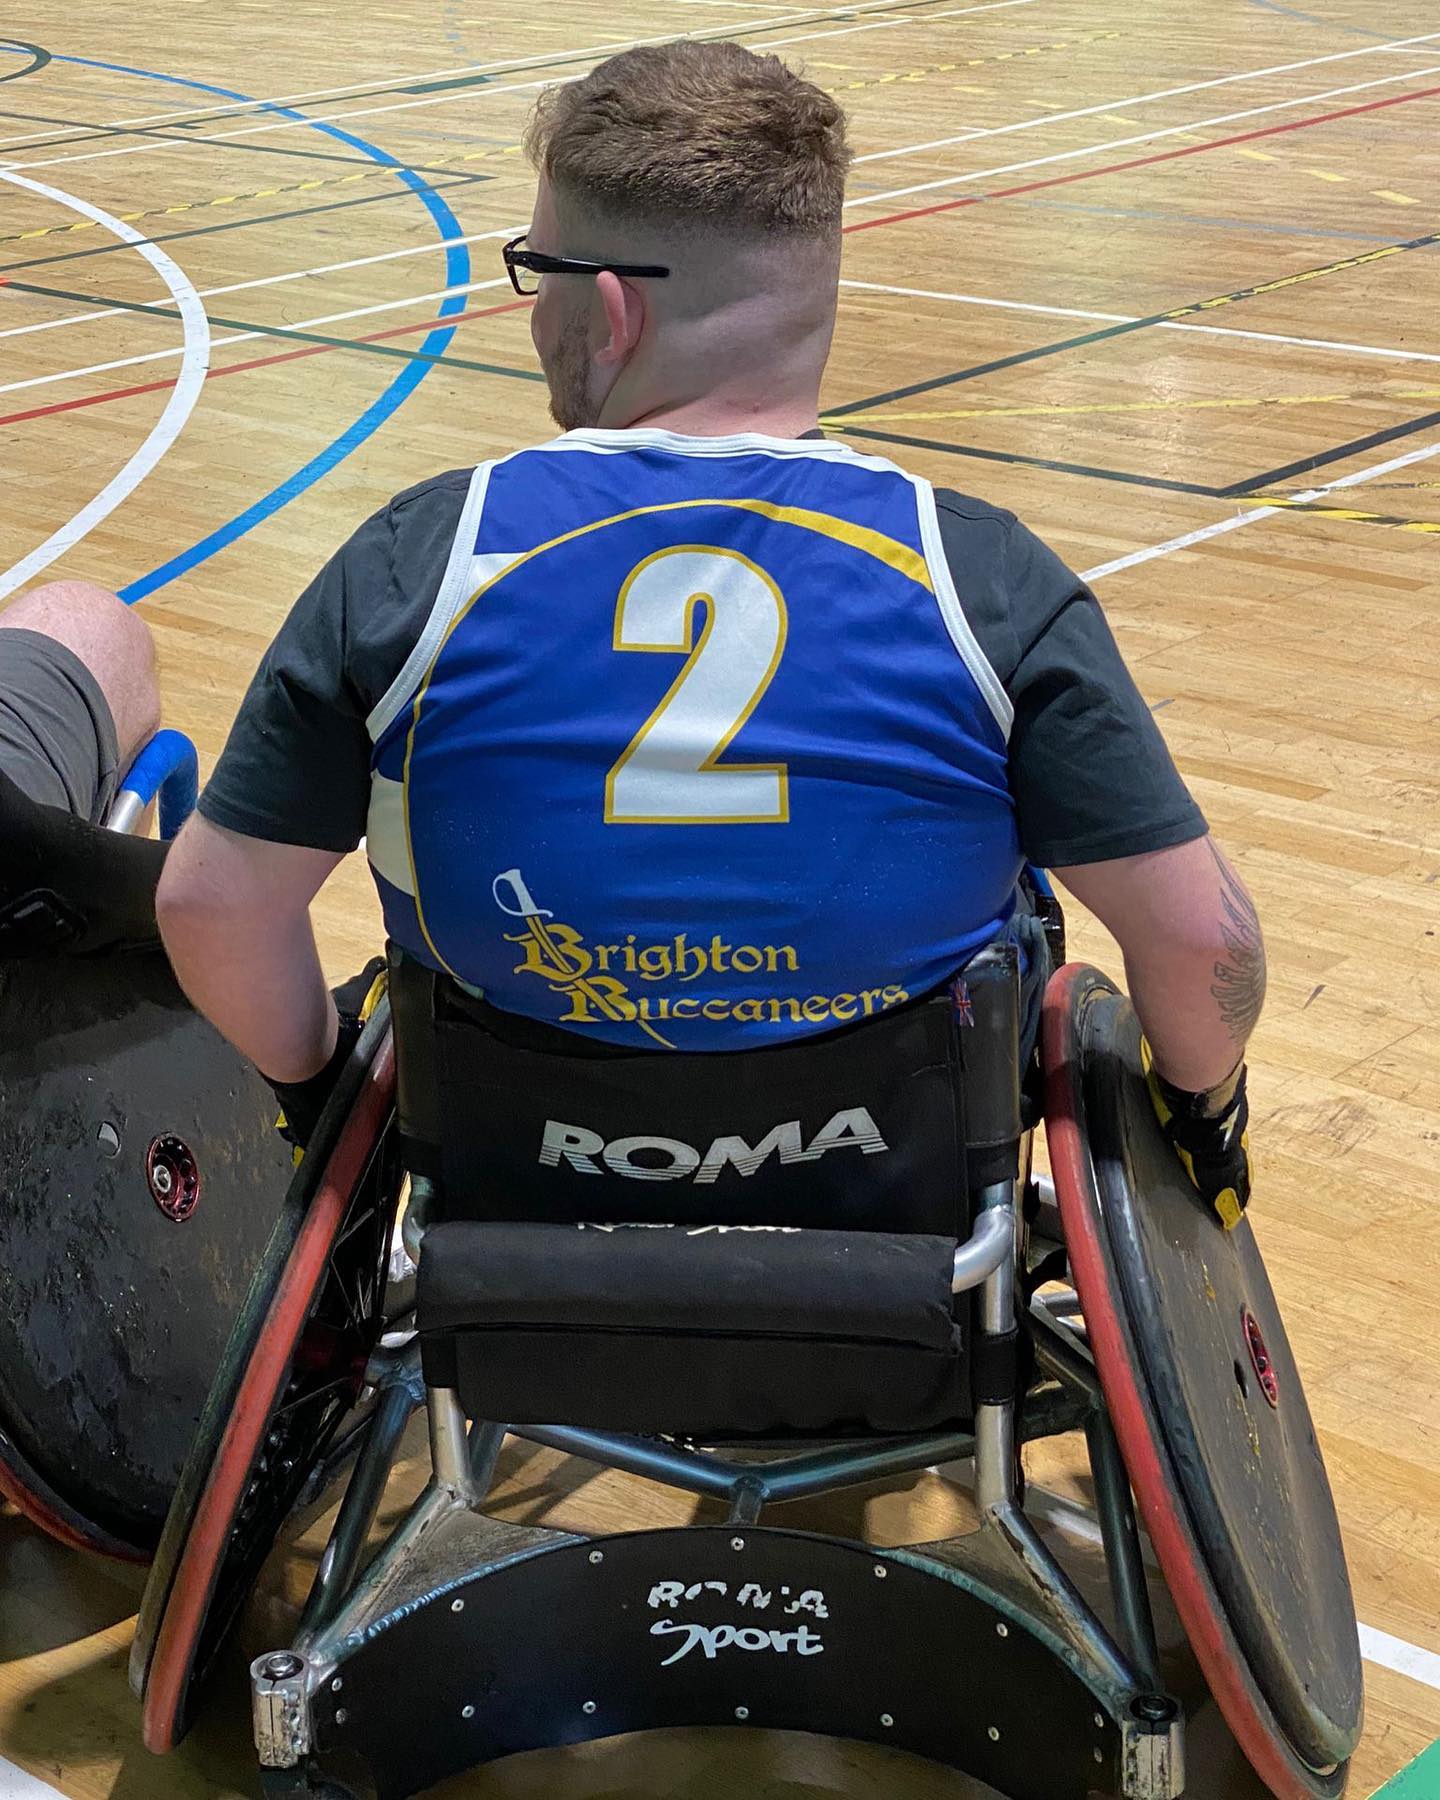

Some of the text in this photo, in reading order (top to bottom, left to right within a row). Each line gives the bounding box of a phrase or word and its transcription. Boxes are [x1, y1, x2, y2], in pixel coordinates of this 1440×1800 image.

[604, 544, 790, 824] 2
[503, 923, 799, 981] Brighton
[549, 975, 909, 1023] Buccaneers
[538, 1107, 889, 1184] ROMA
[650, 1619, 824, 1666] Sport
